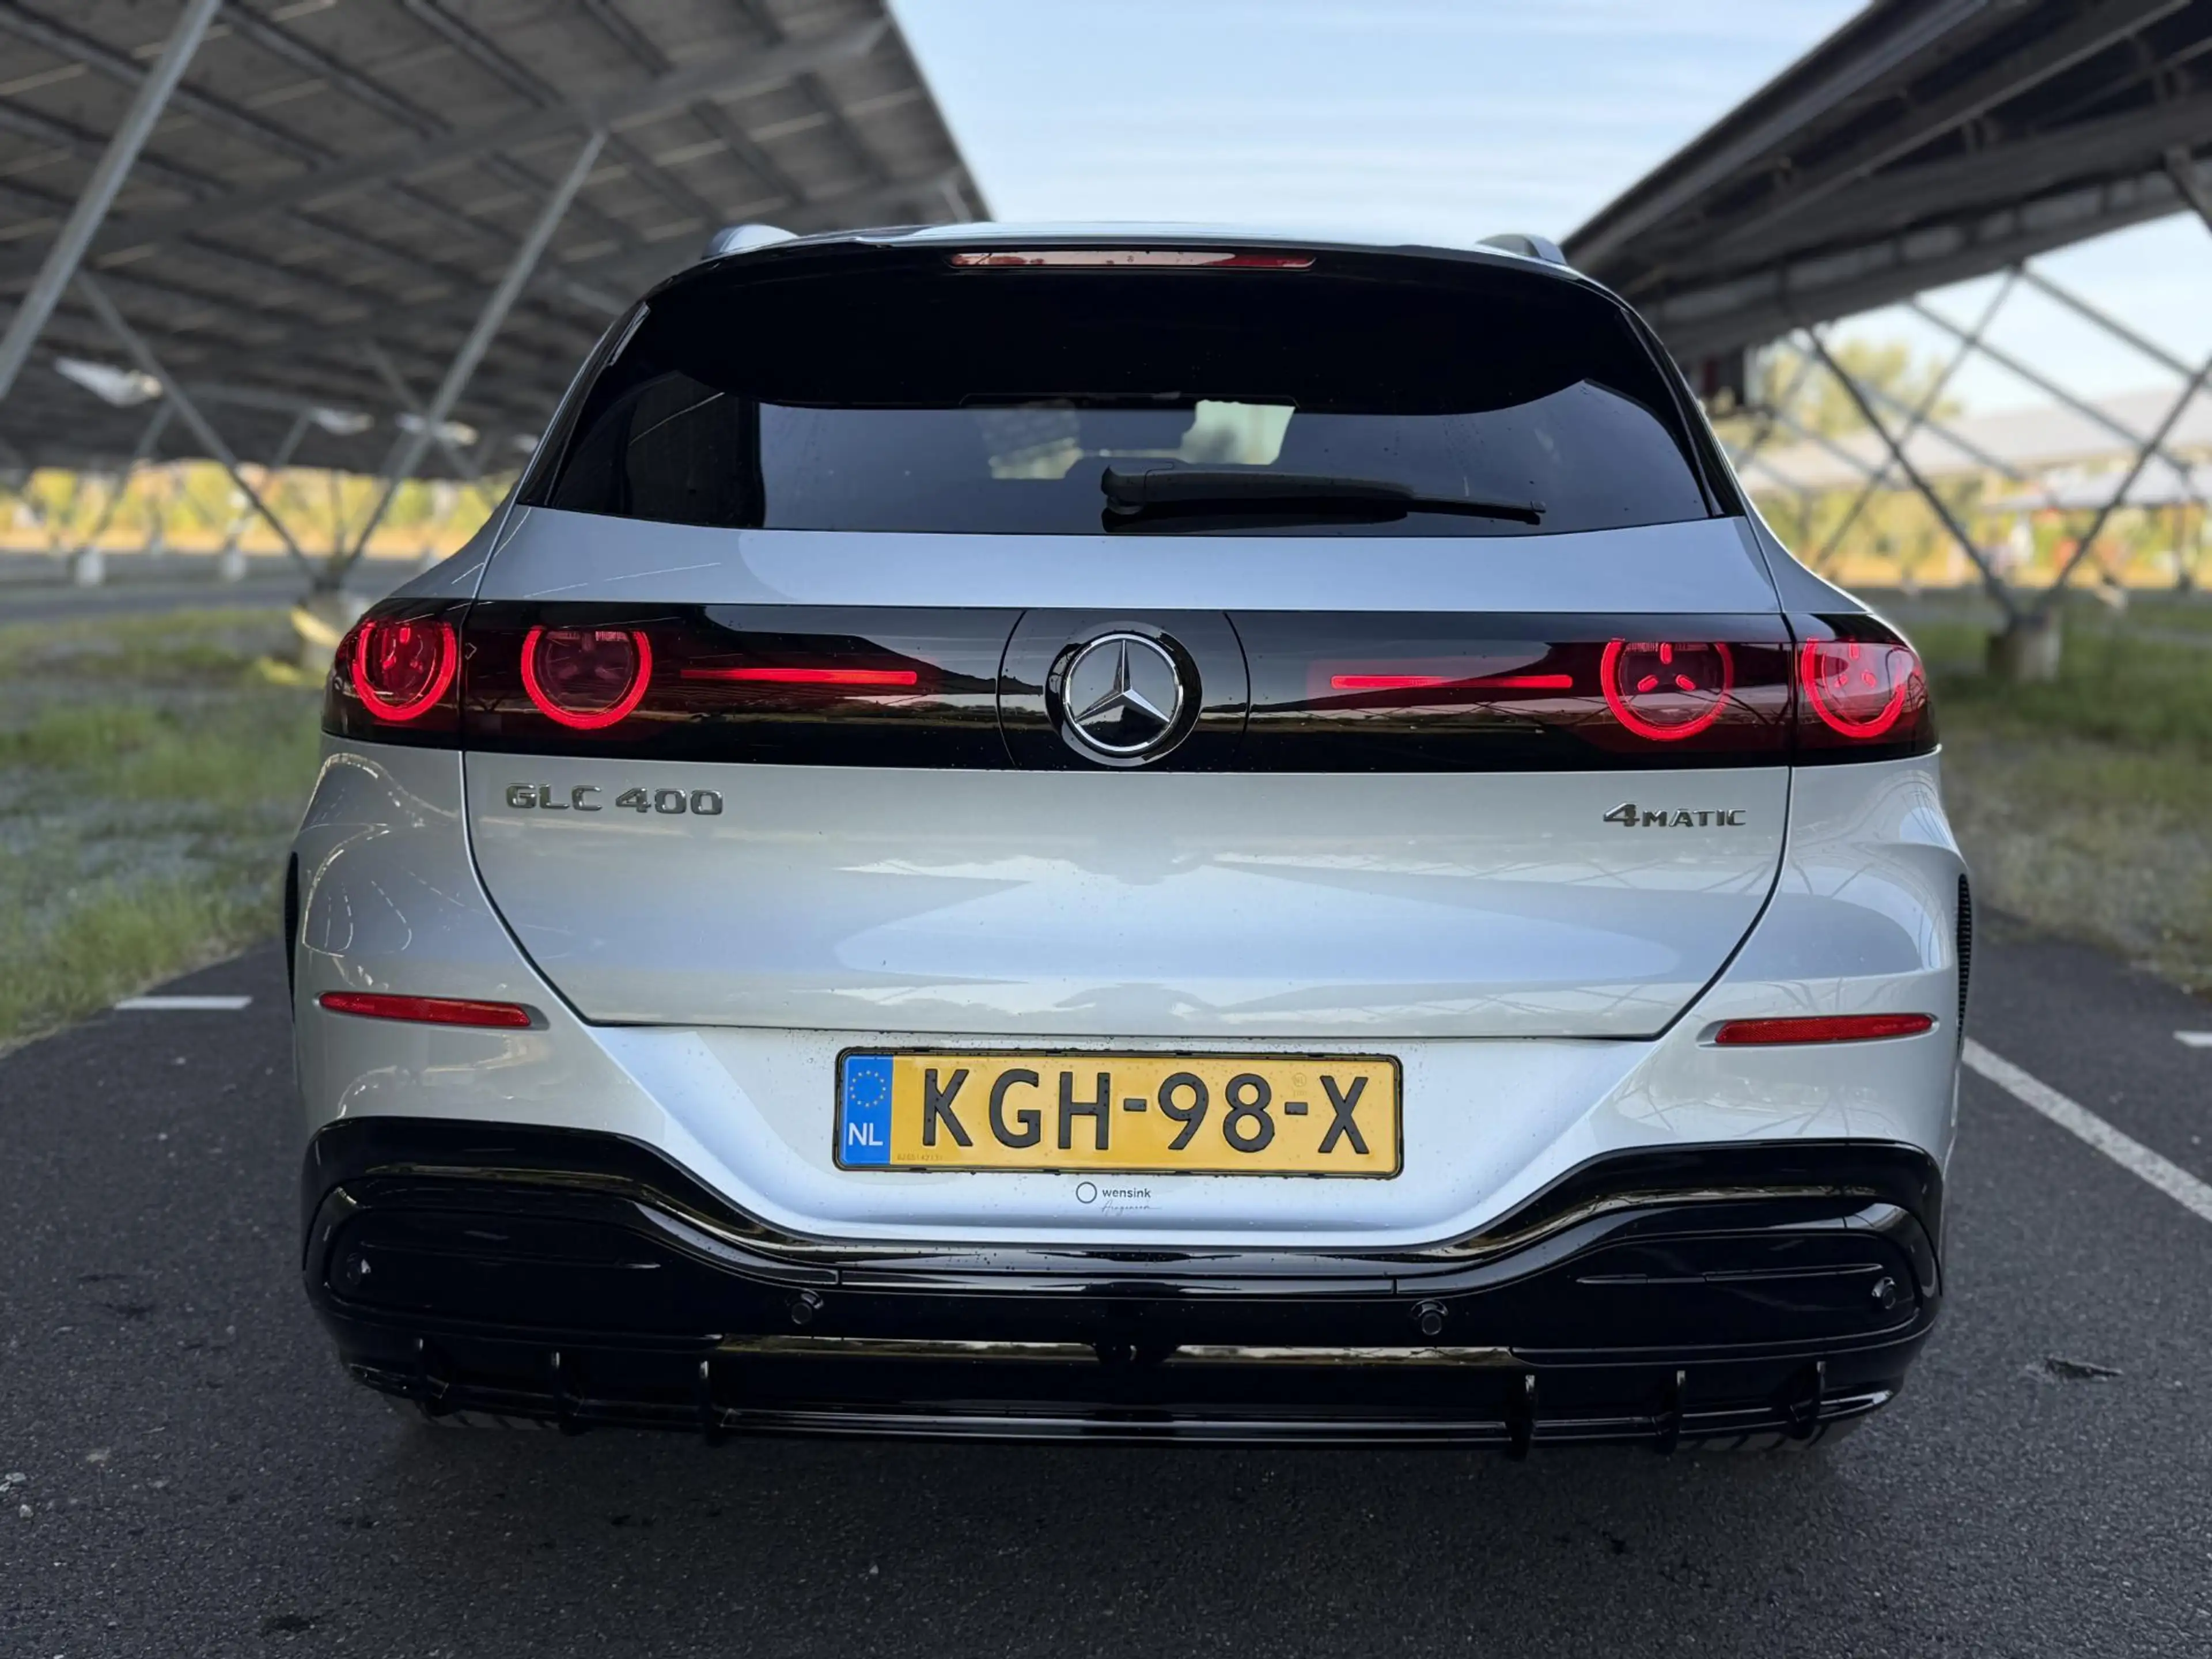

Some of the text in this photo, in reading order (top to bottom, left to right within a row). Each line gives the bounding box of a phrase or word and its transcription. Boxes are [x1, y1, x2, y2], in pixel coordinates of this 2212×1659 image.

[506, 783, 724, 816] GLC 400
[1603, 802, 1747, 827] 4MATIC
[922, 1068, 1370, 1155] KGH-98-X
[849, 1122, 884, 1146] NL
[1102, 1187, 1151, 1199] wensink
